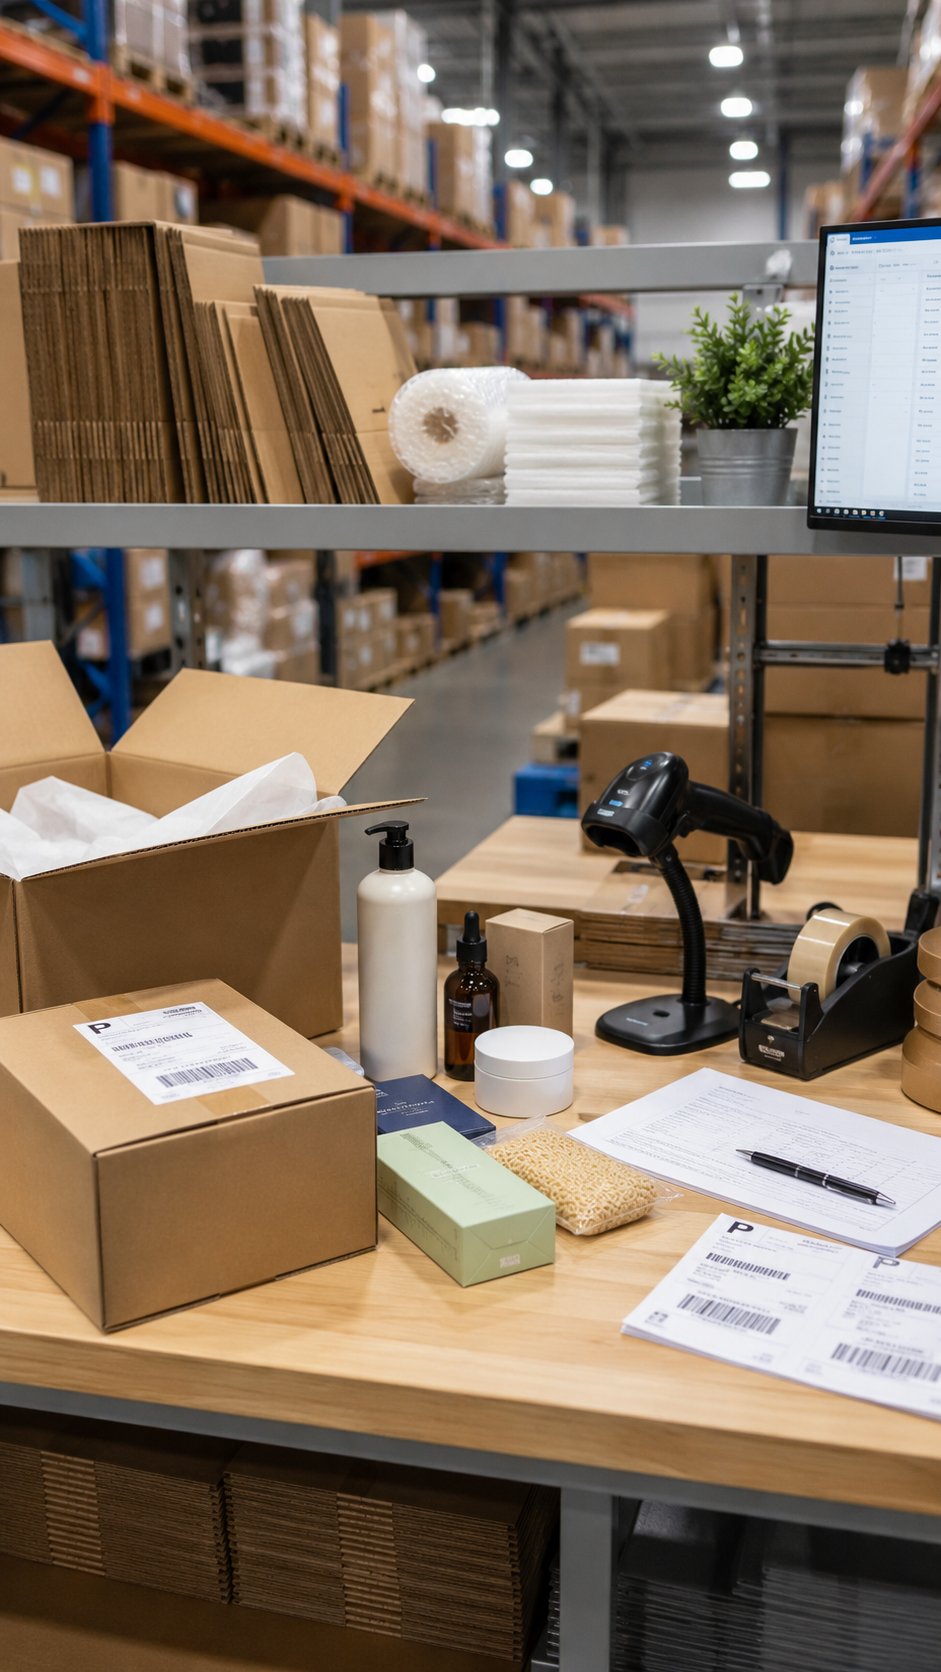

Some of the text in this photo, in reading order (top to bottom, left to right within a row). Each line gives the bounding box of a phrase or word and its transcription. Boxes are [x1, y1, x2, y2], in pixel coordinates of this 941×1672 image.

[88, 1022, 111, 1034] P
[727, 1221, 754, 1233] P
[873, 1256, 900, 1268] P
